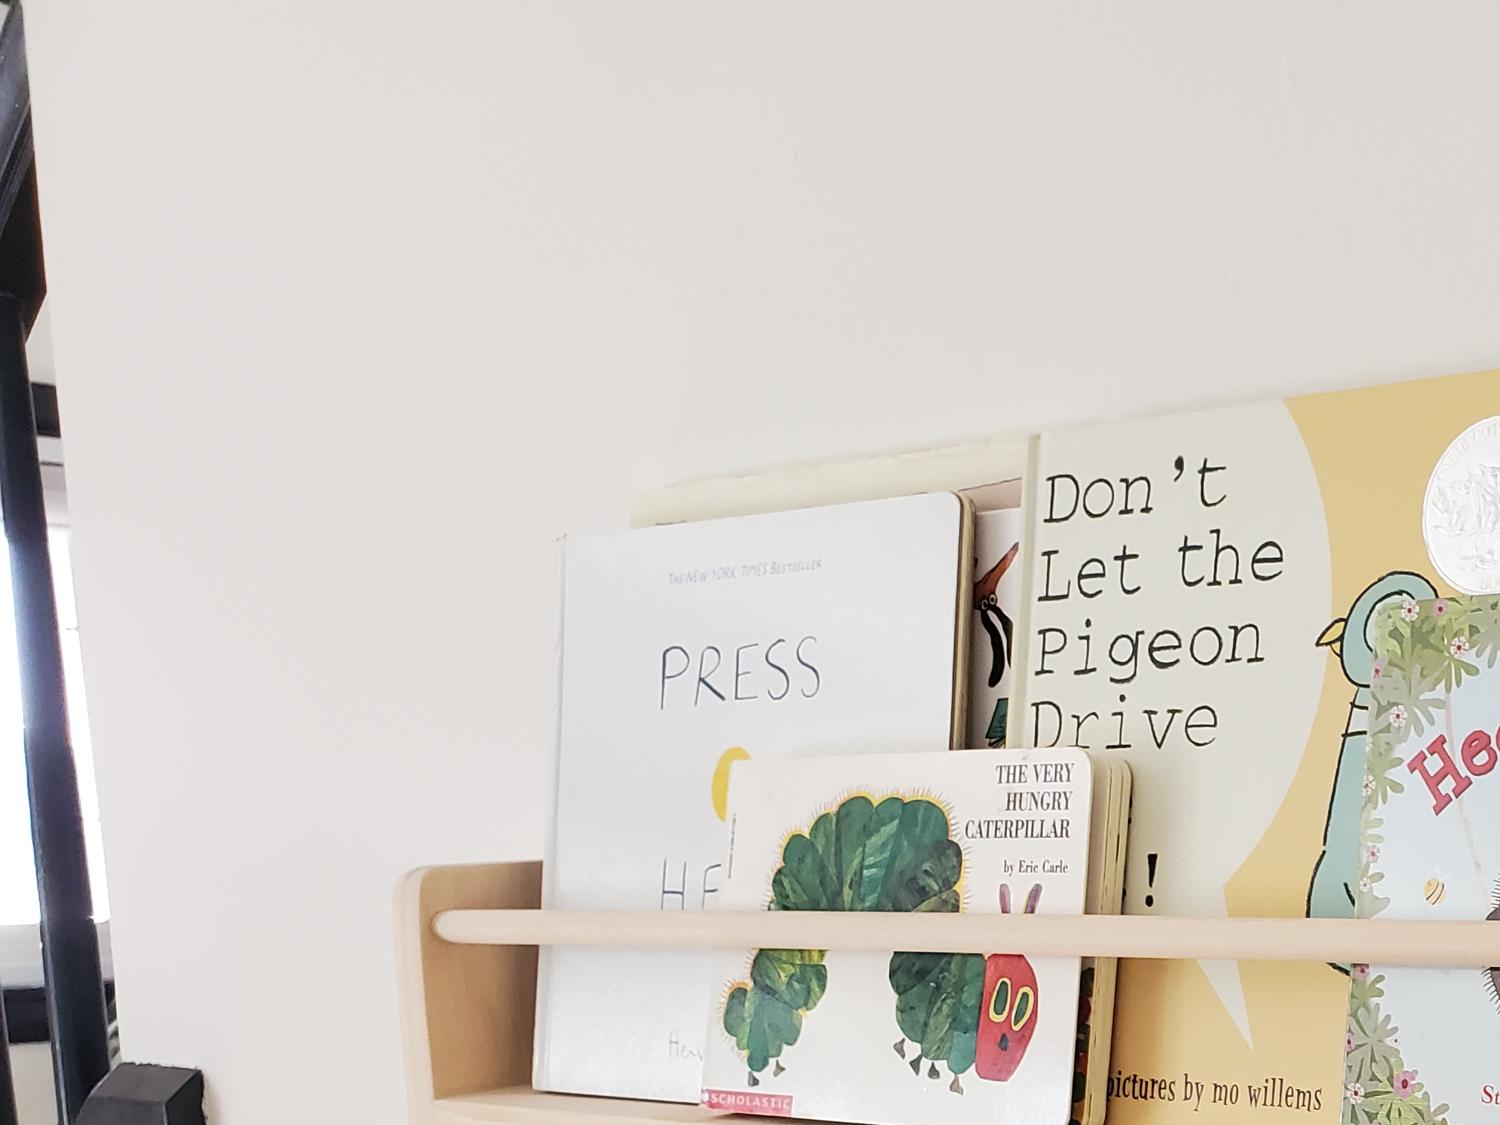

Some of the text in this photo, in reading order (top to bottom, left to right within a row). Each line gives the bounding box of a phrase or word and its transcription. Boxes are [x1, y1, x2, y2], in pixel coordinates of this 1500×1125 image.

[1043, 455, 1228, 524] Don't
[741, 562, 768, 577] TIMES
[1036, 528, 1285, 602] Let the
[1034, 618, 1266, 685] Pigeon
[660, 635, 822, 711] PRESS
[1029, 694, 1219, 748] Drive
[996, 763, 1075, 784] THE VERY
[1005, 791, 1073, 811] HUNGRY
[965, 819, 1070, 839] CATERPILLAR
[1003, 859, 1069, 876] by Eric Carle
[711, 1093, 791, 1111] SCHOLASTIC
[1107, 1070, 1323, 1112] pictures by mo willems
